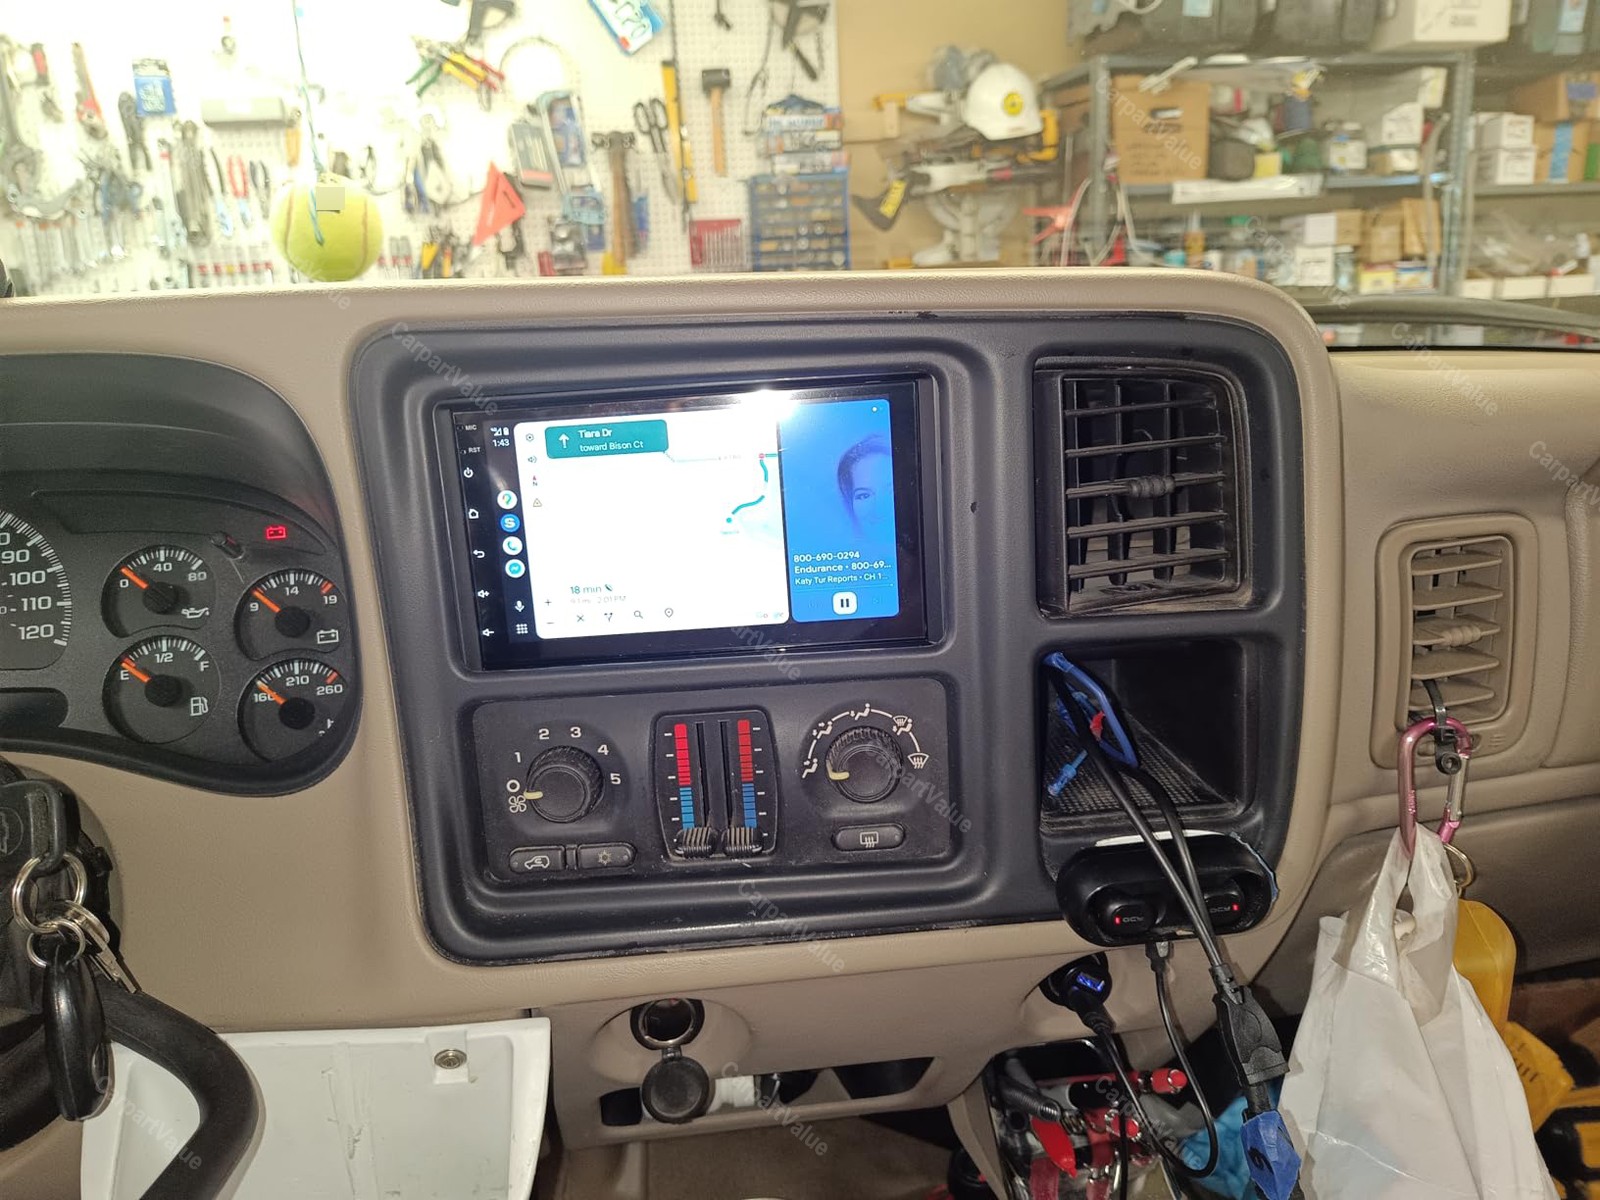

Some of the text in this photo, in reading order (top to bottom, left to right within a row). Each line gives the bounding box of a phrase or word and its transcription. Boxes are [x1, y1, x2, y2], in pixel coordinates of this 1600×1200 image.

[578, 428, 613, 439] Tiara Dr
[492, 438, 510, 447] 1:43
[579, 439, 644, 452] toward Bison Ct
[468, 446, 481, 454] RST
[1, 549, 30, 564] 90
[793, 551, 861, 563] 800-690-0294
[153, 562, 173, 572] 40
[794, 564, 844, 574] Endurance
[9, 570, 46, 586] 100
[188, 571, 207, 582] 80
[795, 577, 813, 586] Katy
[814, 575, 827, 584] Tur
[827, 573, 858, 584] Reports
[119, 579, 129, 588] 0
[285, 586, 299, 596] 14
[570, 585, 602, 595] 18 min
[21, 596, 52, 611] 110
[323, 595, 338, 605] 19
[249, 602, 259, 612] 9
[18, 624, 54, 640] 120
[154, 652, 173, 663] 1/2
[200, 661, 210, 671] F
[120, 670, 130, 681] E
[285, 675, 310, 687] 210
[315, 684, 344, 696] 260
[538, 726, 582, 740] 2 3
[514, 744, 609, 763] 1 4
[610, 773, 621, 785] 5
